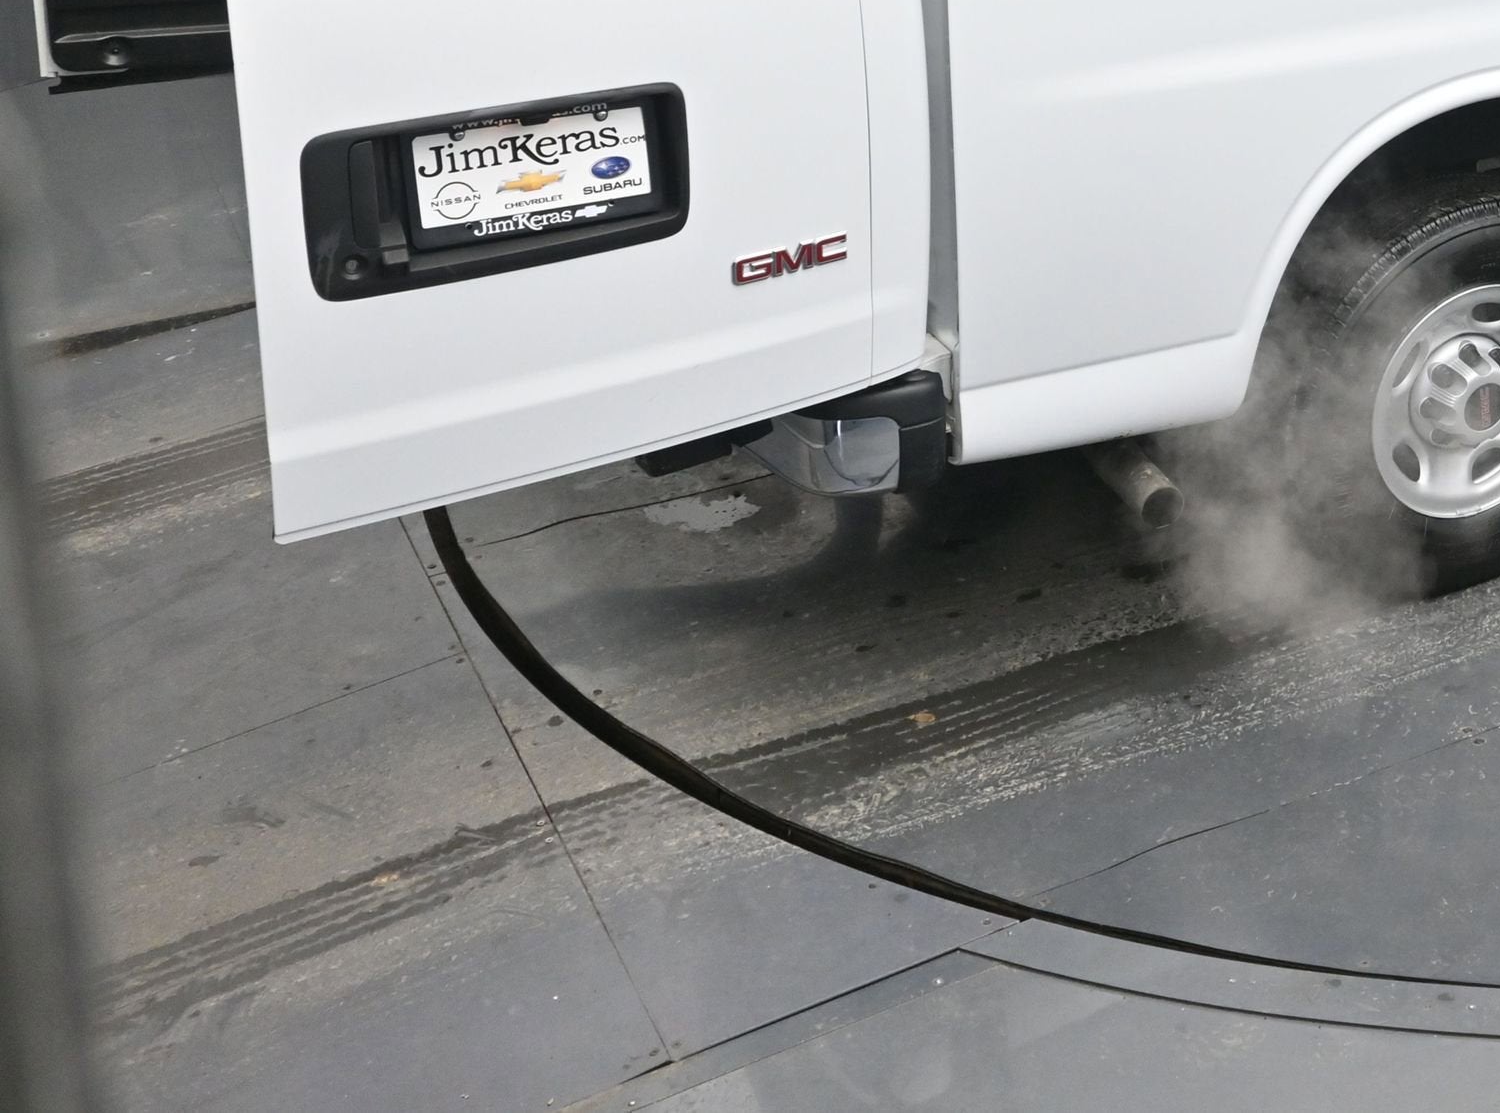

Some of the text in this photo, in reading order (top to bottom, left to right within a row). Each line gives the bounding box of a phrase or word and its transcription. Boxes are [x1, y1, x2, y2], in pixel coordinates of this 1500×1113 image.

[582, 177, 643, 196] SUBARU
[430, 193, 482, 208] NISSAN
[504, 194, 564, 210] CHEVROLET
[731, 230, 848, 286] GMC
